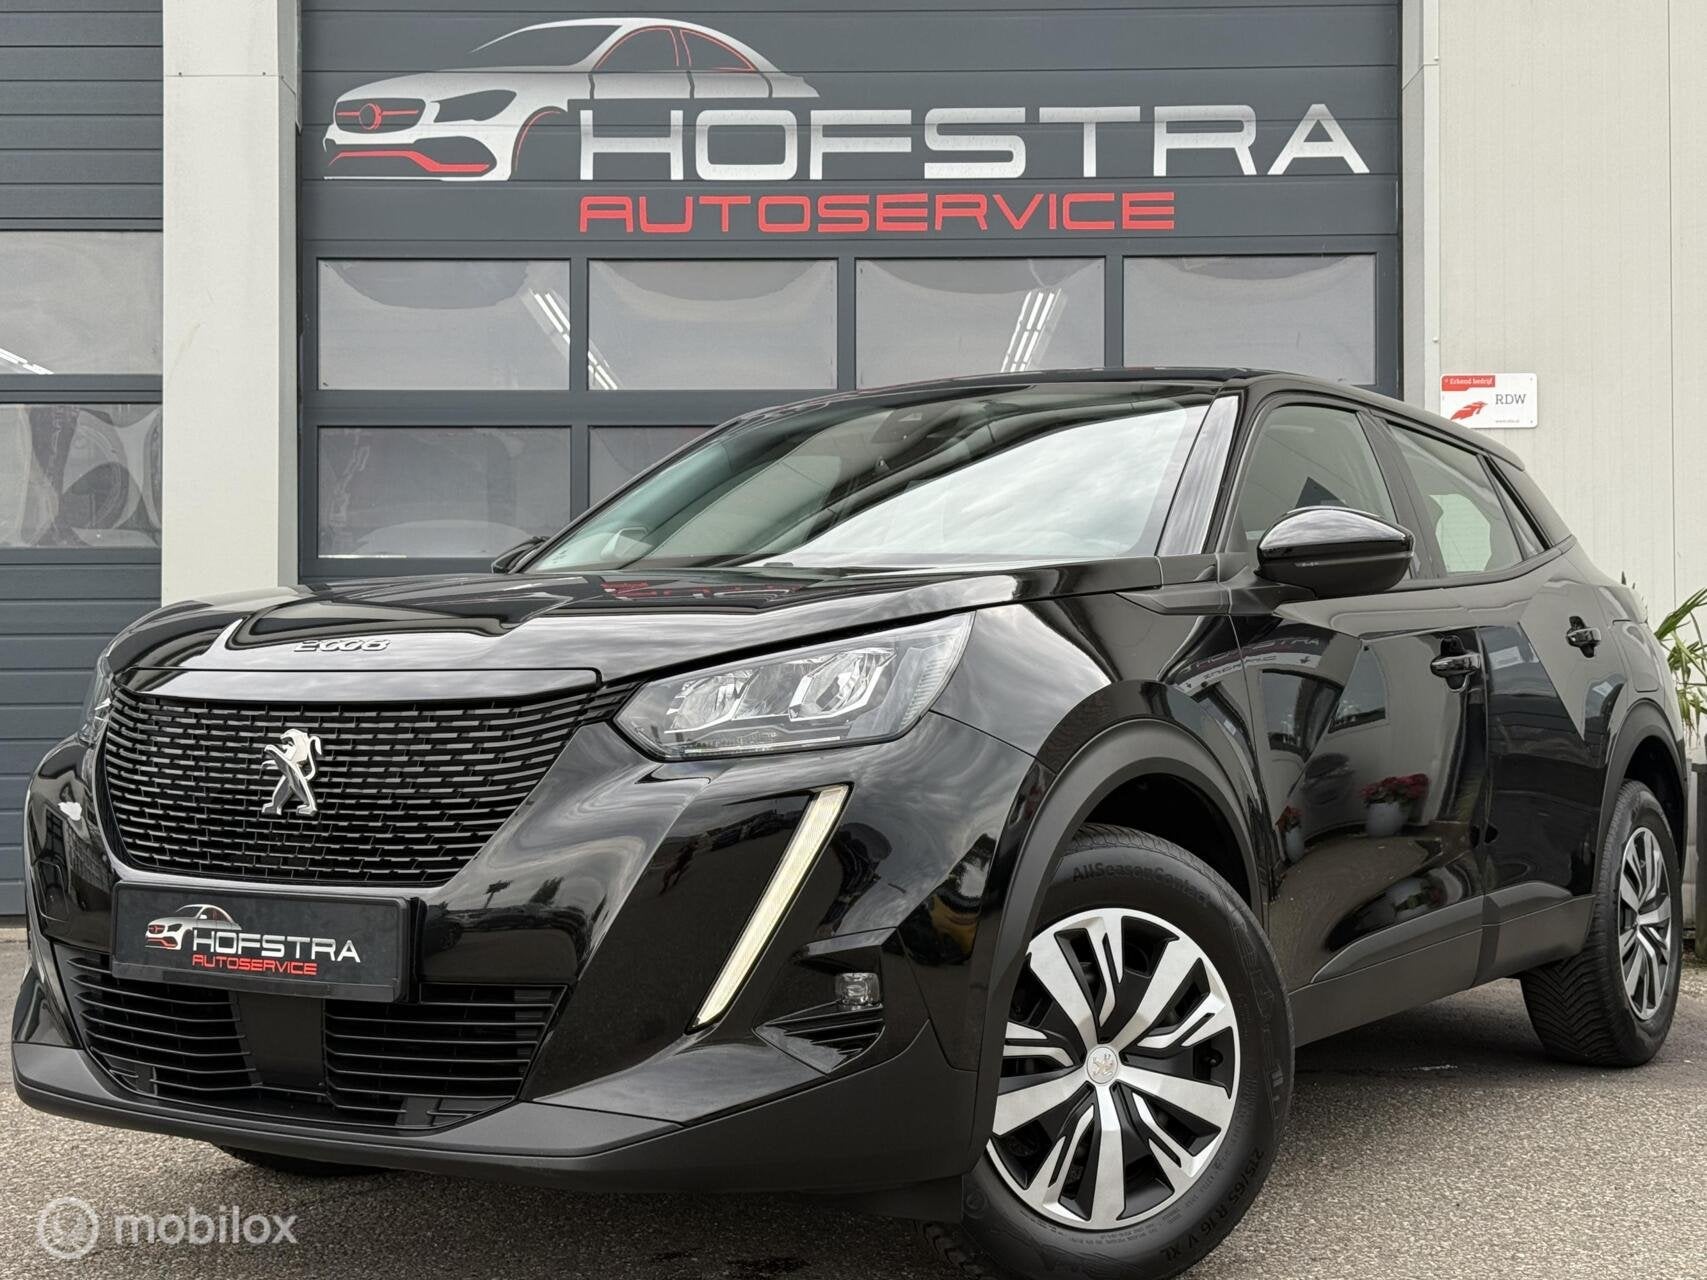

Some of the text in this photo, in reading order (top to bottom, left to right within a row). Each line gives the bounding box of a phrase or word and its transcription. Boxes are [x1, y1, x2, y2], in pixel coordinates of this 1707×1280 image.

[579, 103, 1370, 181] HOFSTRA
[579, 191, 1175, 233] AUTOSERVICE
[1495, 393, 1526, 405] RDW
[193, 929, 361, 963] HOFSTRA
[192, 954, 318, 976] AUTOSERVICE
